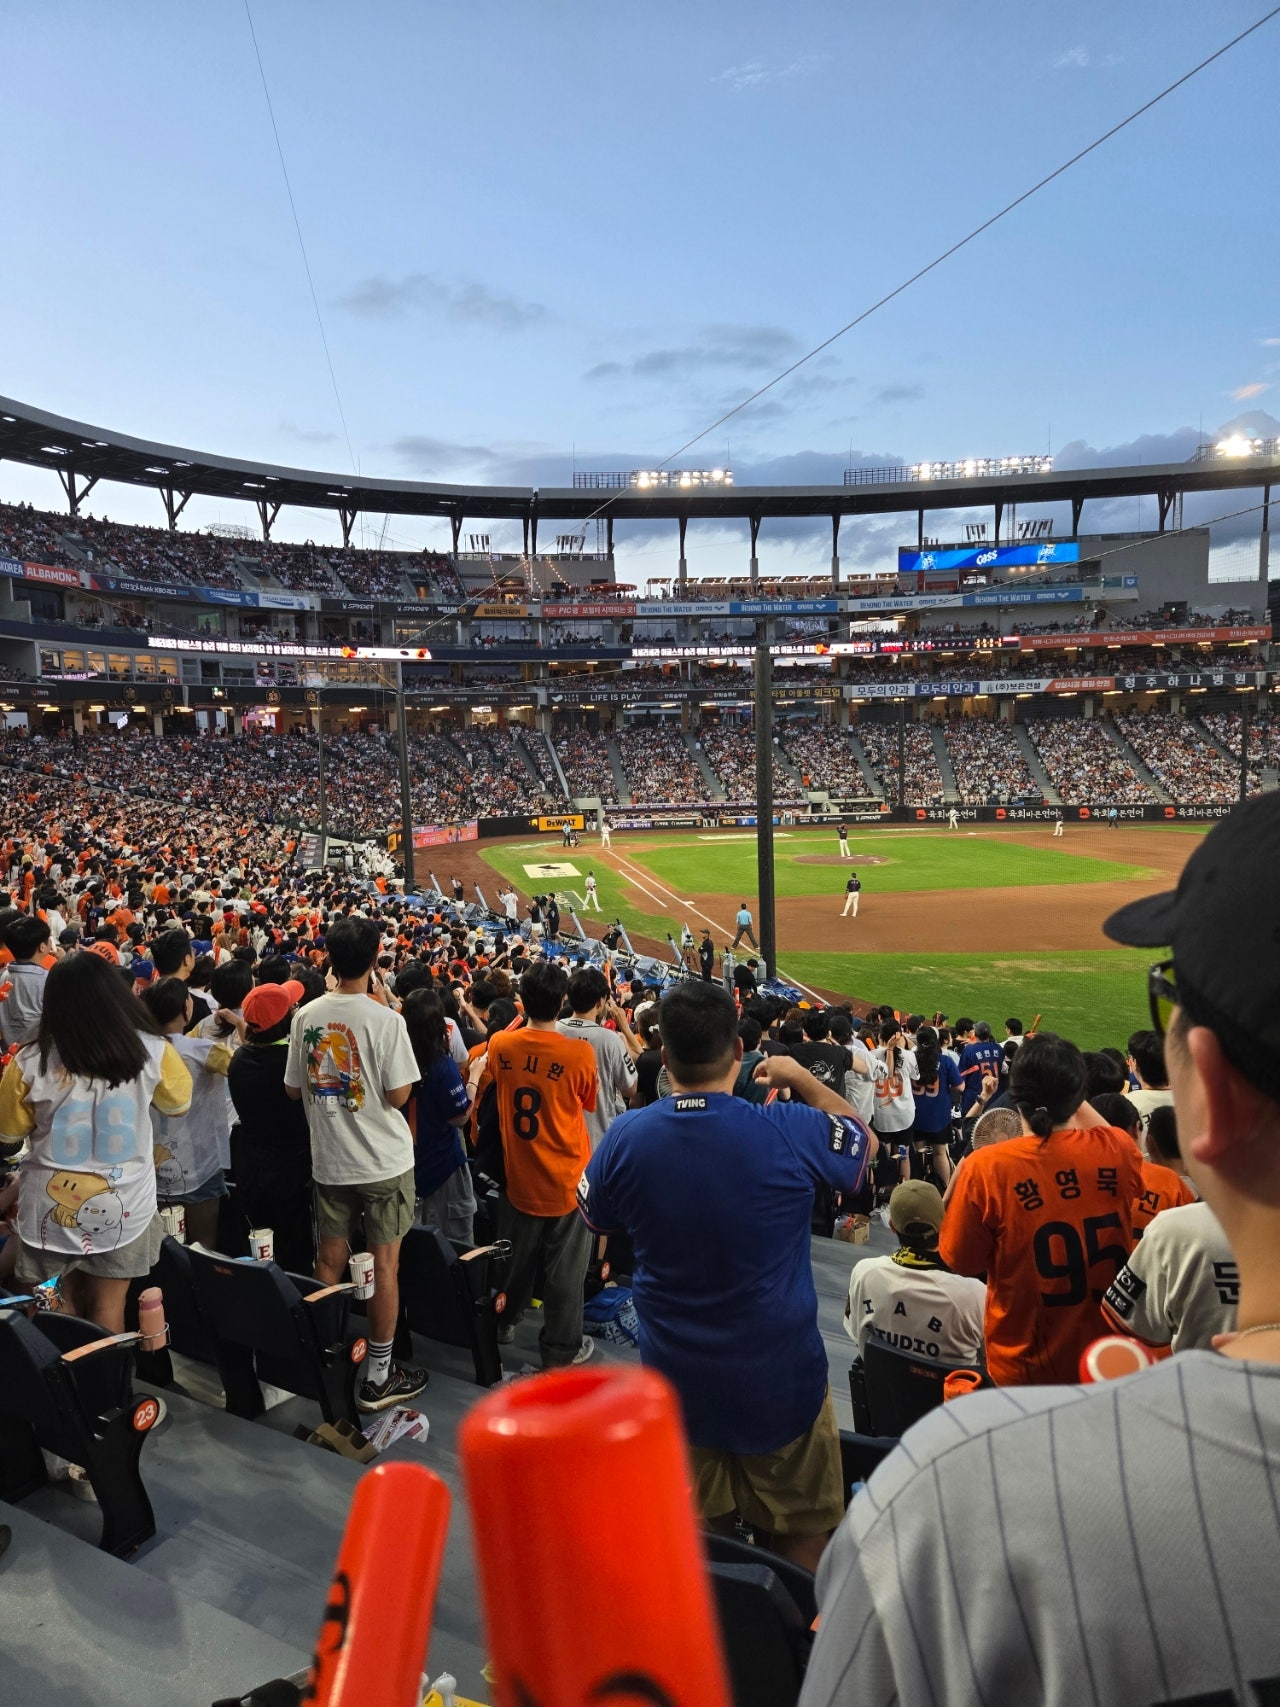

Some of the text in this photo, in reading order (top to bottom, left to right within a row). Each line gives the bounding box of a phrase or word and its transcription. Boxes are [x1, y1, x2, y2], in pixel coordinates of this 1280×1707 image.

[26, 568, 72, 586] ALBAMON
[975, 596, 998, 604] BEYOND
[641, 605, 692, 614] BEYOND THE WATER
[741, 604, 762, 612] BEYOND
[773, 603, 792, 611] WATER
[661, 648, 683, 657] 이글스의
[781, 646, 803, 654] 이글스의
[788, 689, 811, 698] 아울렛
[814, 687, 840, 697] 워크업
[857, 685, 910, 696] 모두의 안과
[920, 682, 975, 694] 모두의 안과
[995, 682, 1041, 691] (주)보은건설
[590, 694, 608, 702] LIFE
[621, 693, 642, 701] PLAY
[1177, 807, 1231, 817] 육회바른연어
[499, 1053, 565, 1083] 노시환
[676, 1098, 706, 1109] TVING
[513, 1087, 542, 1141] 8
[51, 1095, 138, 1166] 68
[1013, 1166, 1119, 1212] 황영묵
[258, 1244, 272, 1259] E
[1033, 1212, 1129, 1308] 95
[362, 1268, 374, 1285] E
[865, 1323, 941, 1358] STUDIO
[352, 1342, 367, 1359] 22
[136, 1404, 155, 1427] 23
